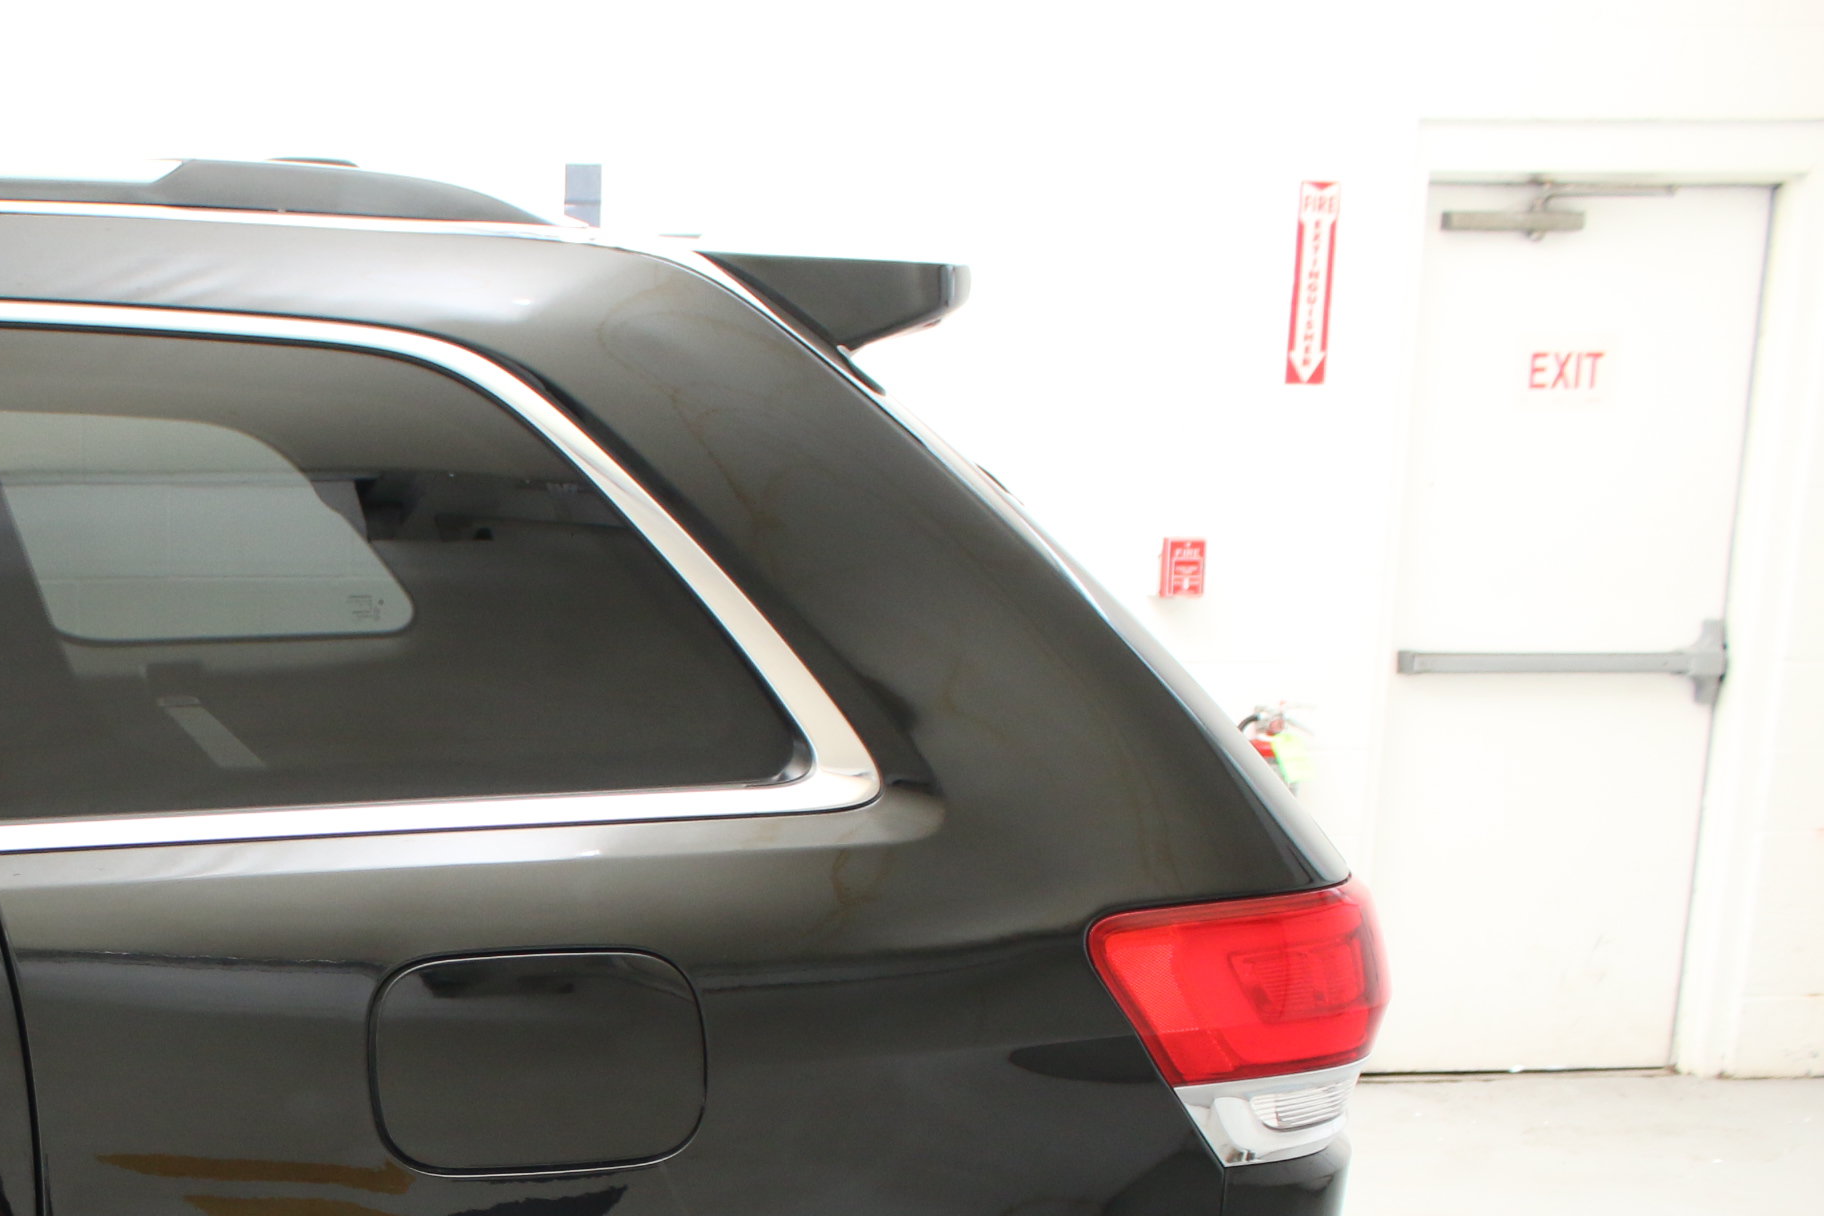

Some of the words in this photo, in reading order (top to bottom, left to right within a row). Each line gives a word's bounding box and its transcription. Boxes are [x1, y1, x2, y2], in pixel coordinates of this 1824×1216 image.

[1302, 193, 1338, 214] FIRE
[1301, 219, 1323, 367] EXTINGUISHER
[1527, 350, 1606, 390] EXIT
[1174, 547, 1201, 559] FIRE
